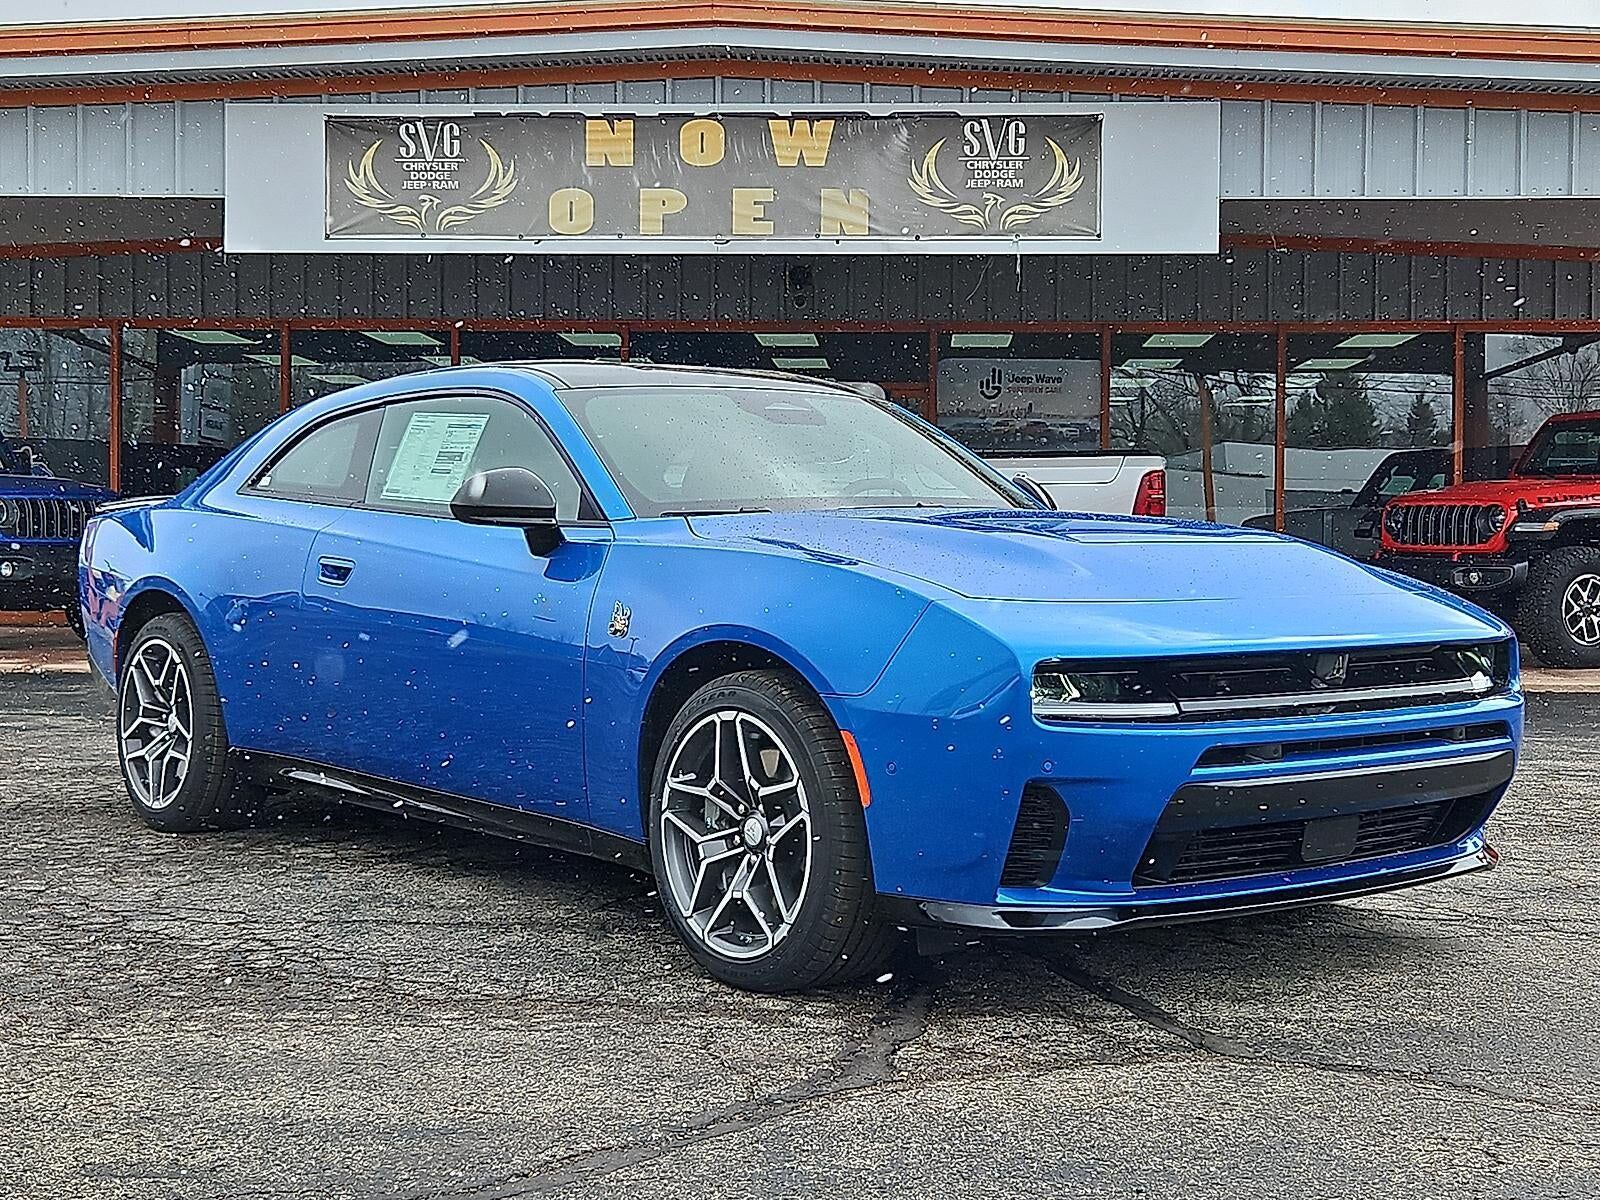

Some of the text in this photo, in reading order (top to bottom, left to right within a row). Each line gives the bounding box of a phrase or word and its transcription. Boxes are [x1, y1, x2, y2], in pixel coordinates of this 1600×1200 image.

[399, 121, 460, 162] SVG
[585, 118, 835, 167] NOW
[963, 118, 1026, 161] SVG
[402, 162, 459, 171] CHRYSLER
[966, 160, 1024, 170] CHRYSLER
[410, 171, 451, 180] DODGE
[974, 169, 1016, 179] DODGE
[548, 187, 871, 236] OPEN
[1007, 373, 1062, 385] Jeep Wave
